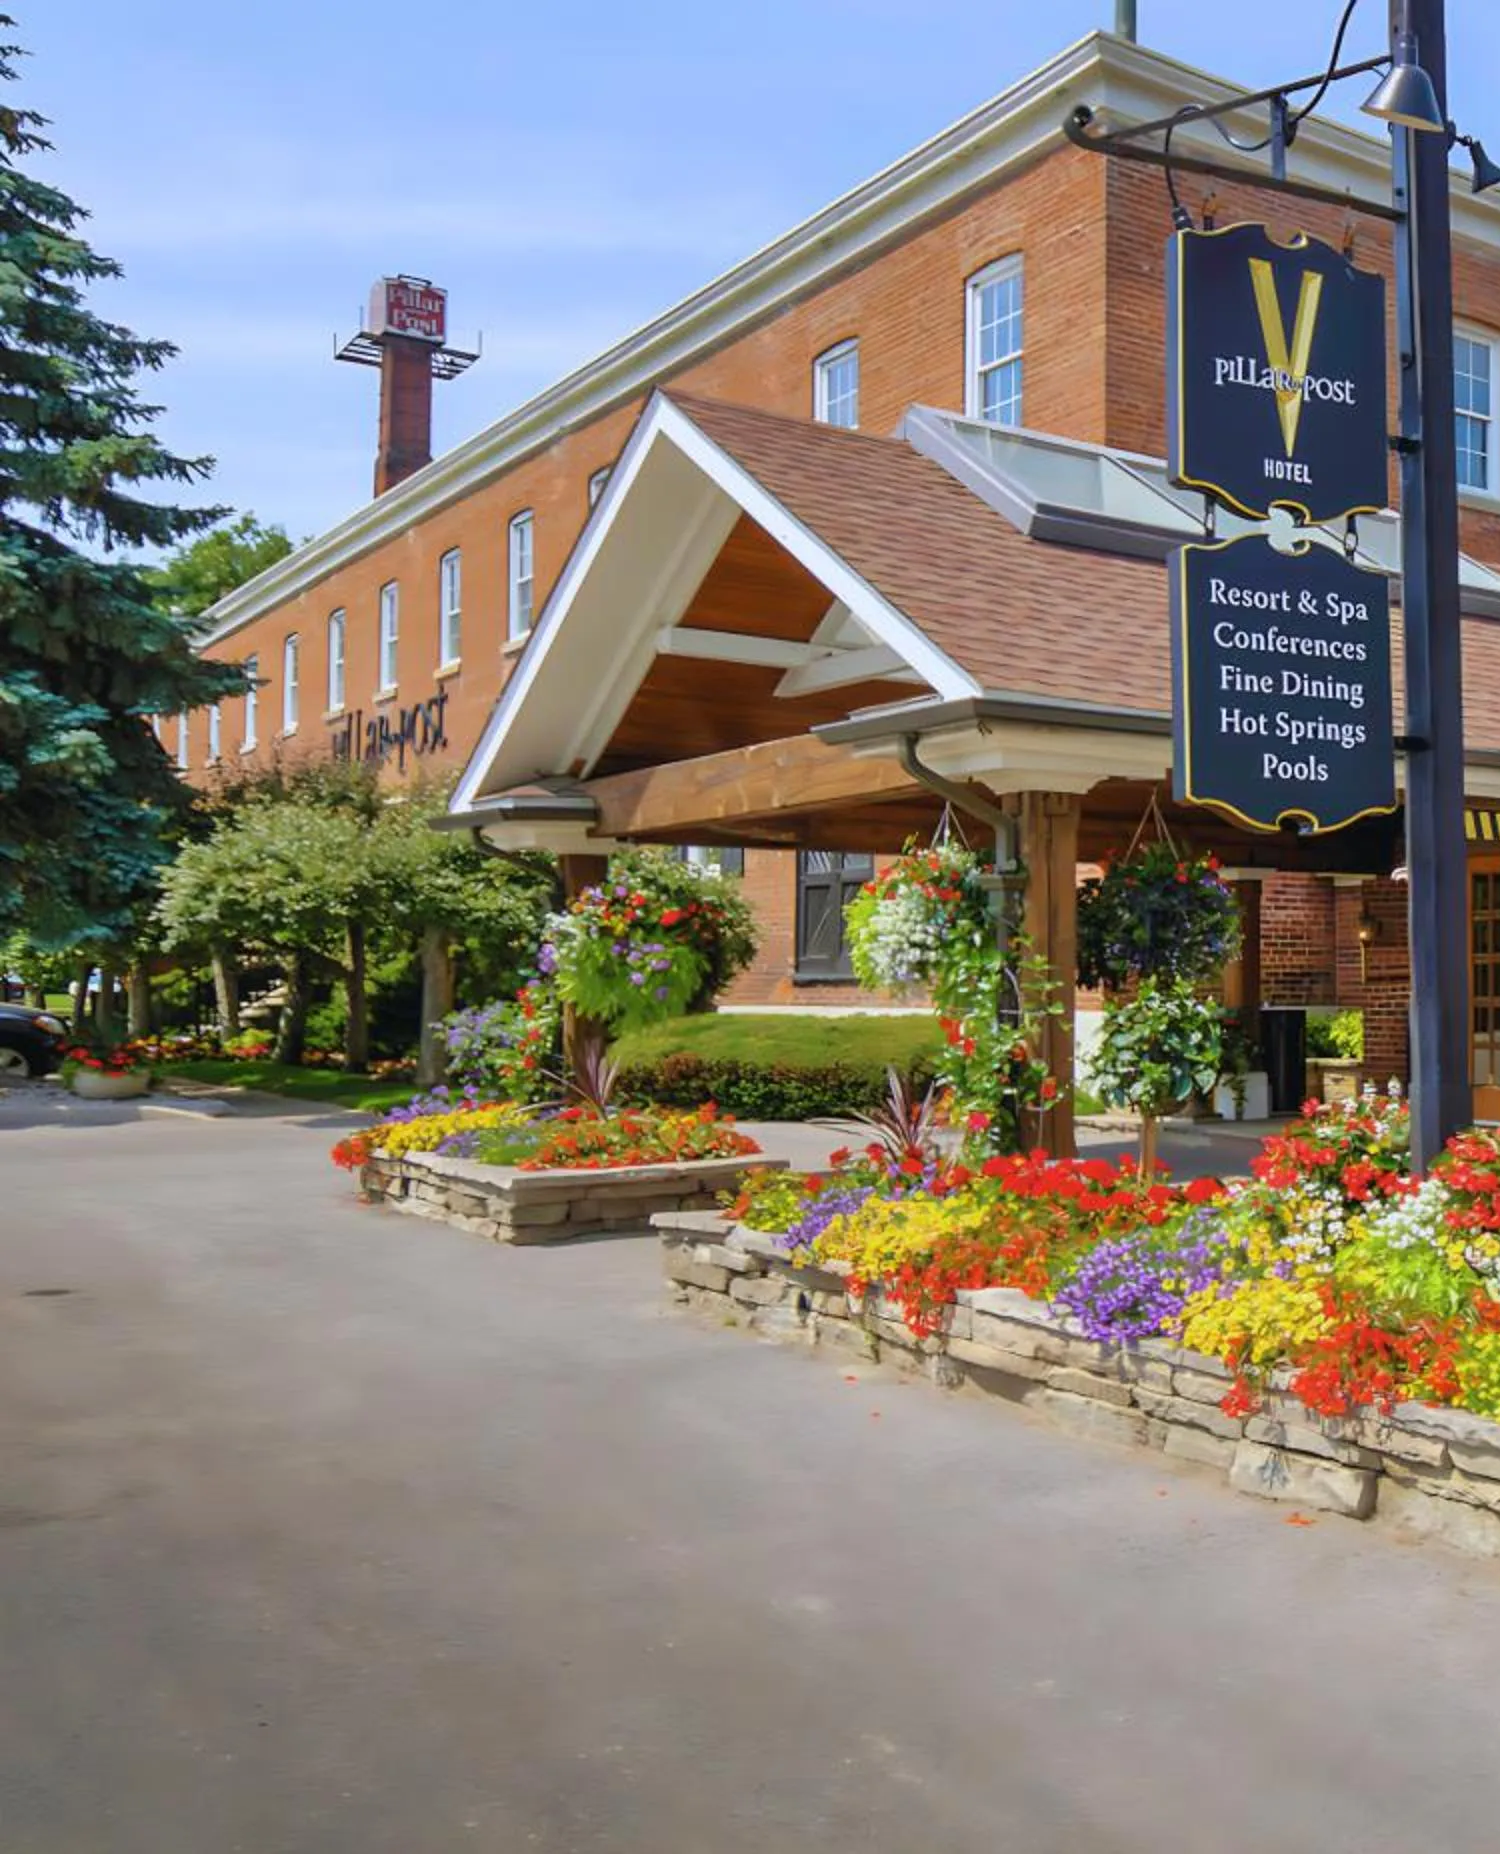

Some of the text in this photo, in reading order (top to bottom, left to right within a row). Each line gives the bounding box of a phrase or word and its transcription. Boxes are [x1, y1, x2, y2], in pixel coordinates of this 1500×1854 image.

[1263, 457, 1313, 485] HOTEL
[1209, 578, 1369, 625] Resort & Spa
[1213, 621, 1367, 661] Conferences
[1220, 664, 1364, 709] Fine Dining
[1220, 707, 1367, 749] Hot Springs
[1263, 752, 1329, 782] Pools
